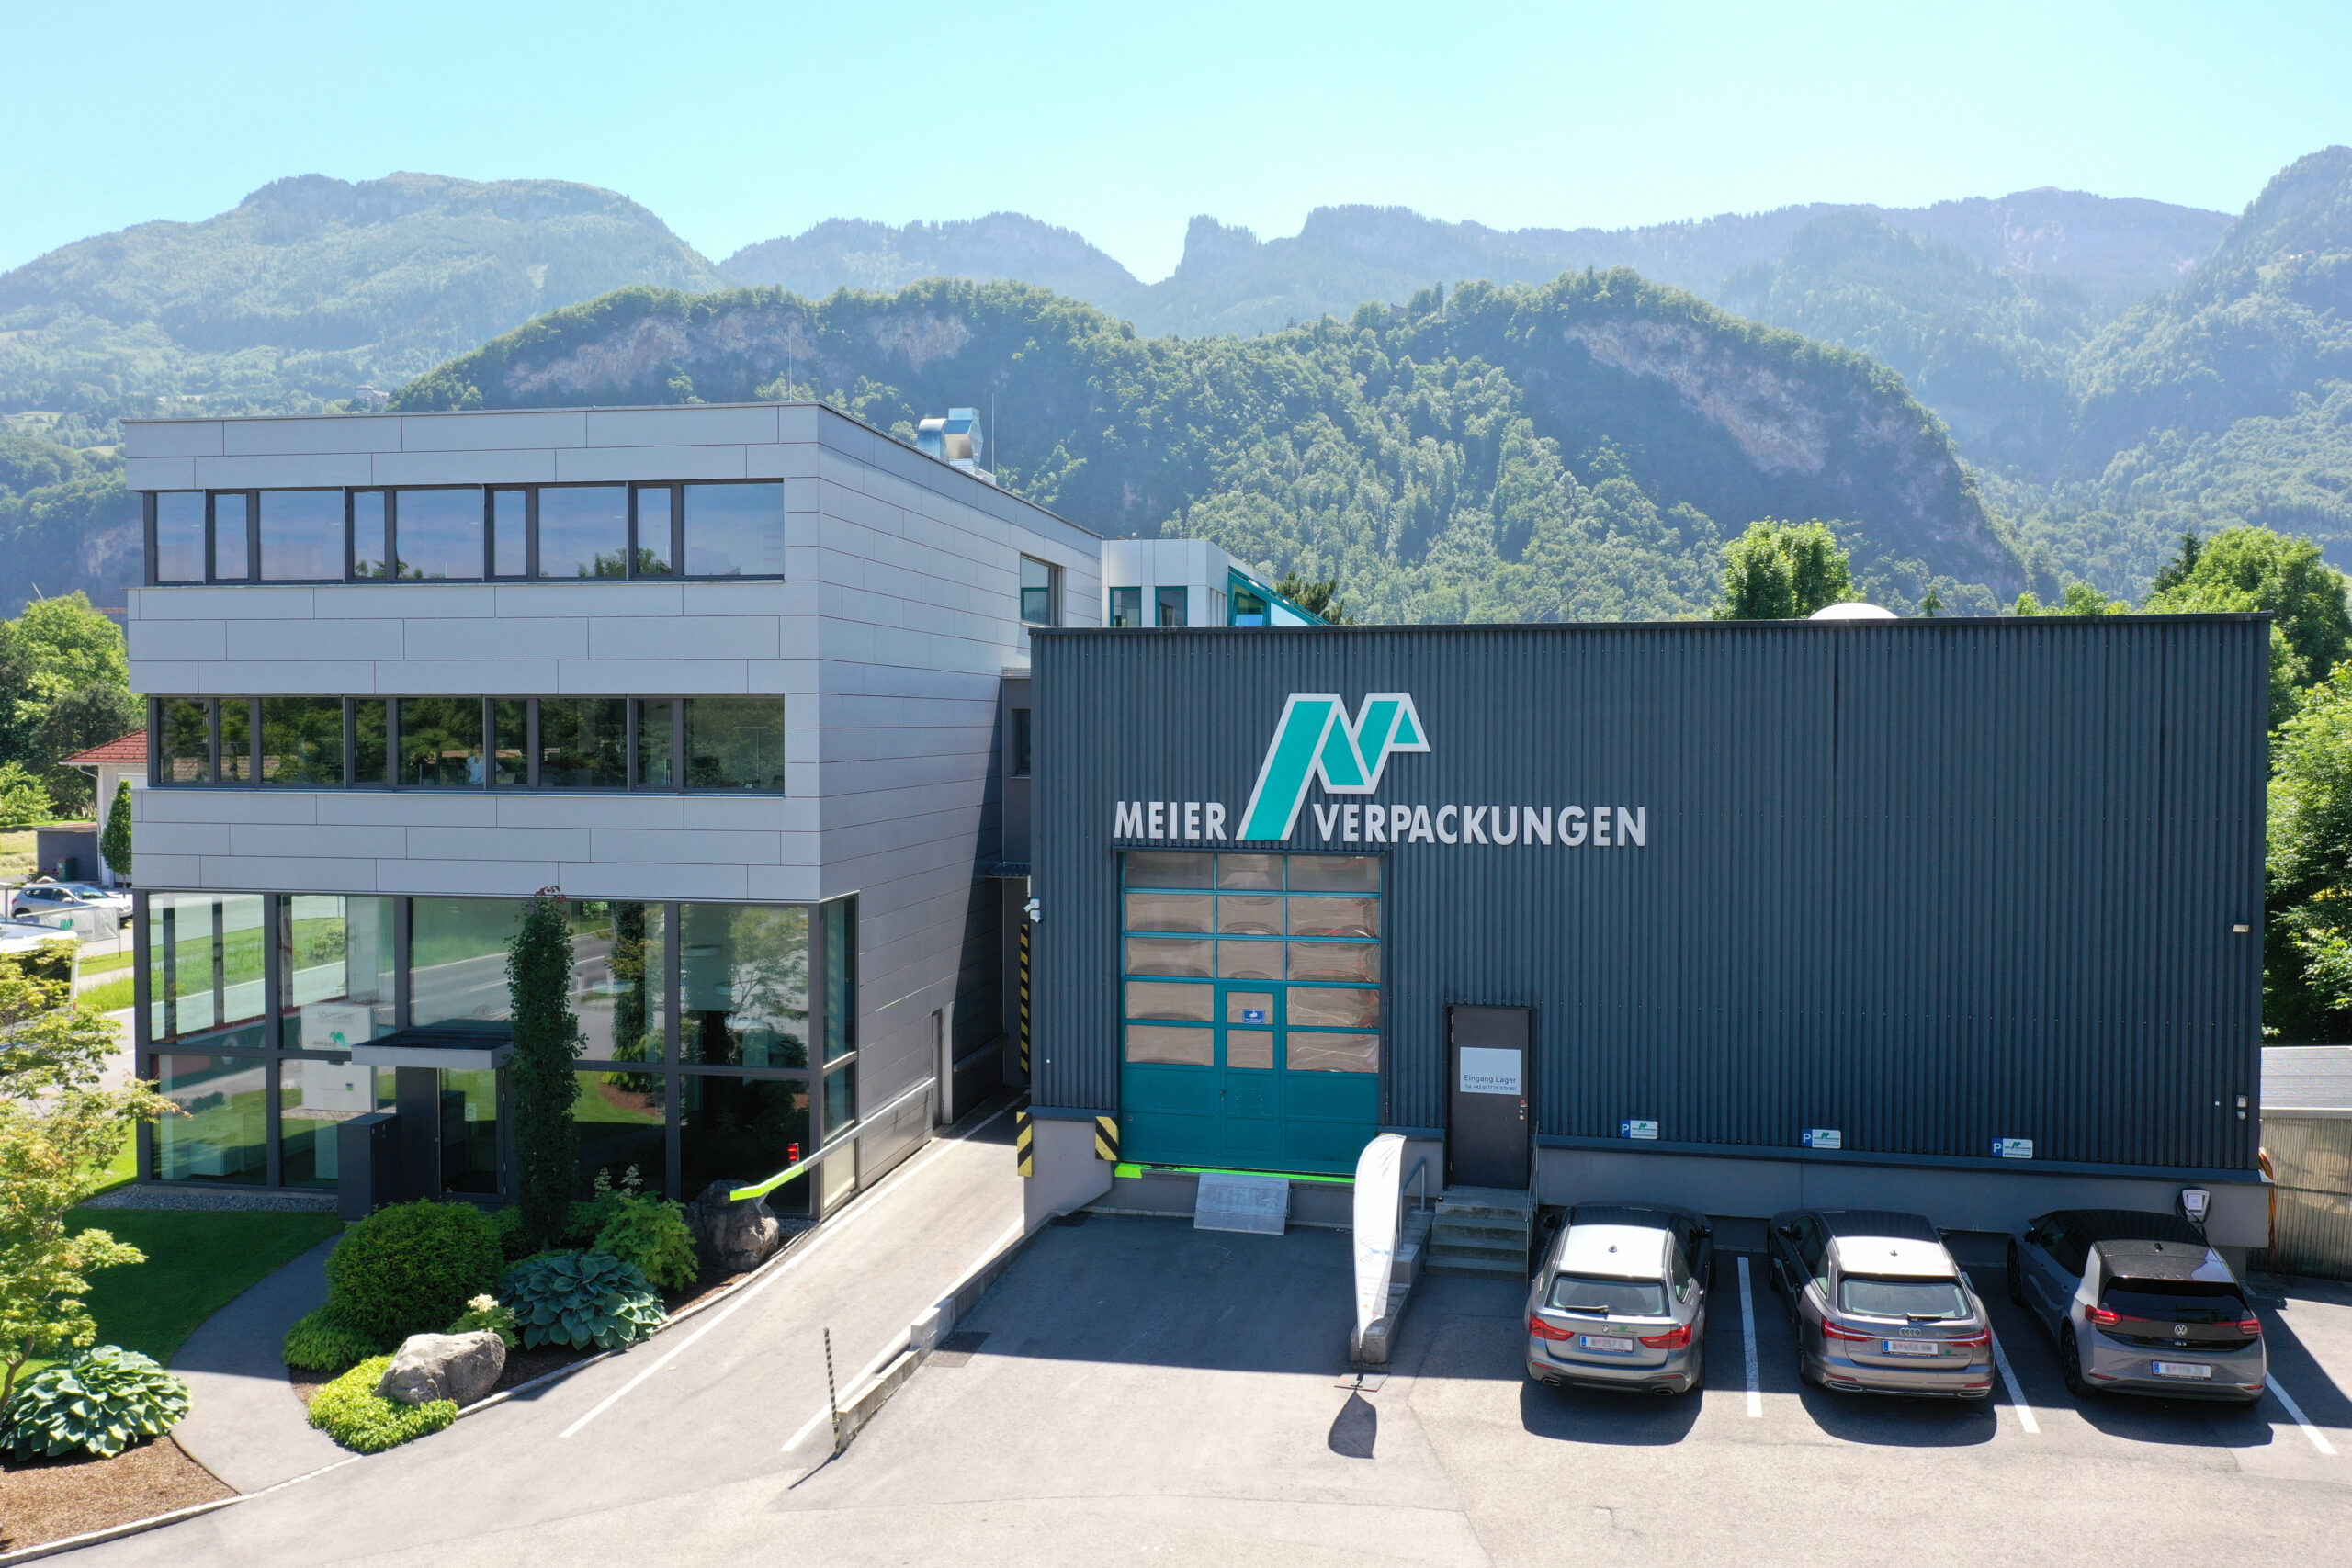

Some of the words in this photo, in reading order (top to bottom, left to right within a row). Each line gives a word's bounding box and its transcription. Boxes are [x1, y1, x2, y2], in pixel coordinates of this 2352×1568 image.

[1114, 801, 1227, 840] MEIER
[1313, 804, 1645, 846] VERPACKUNGEN
[1464, 1074, 1494, 1083] Eingang
[1496, 1076, 1516, 1085] Lager
[1622, 1123, 1630, 1134] P
[1804, 1133, 1812, 1143] P
[1994, 1142, 2002, 1153] P
